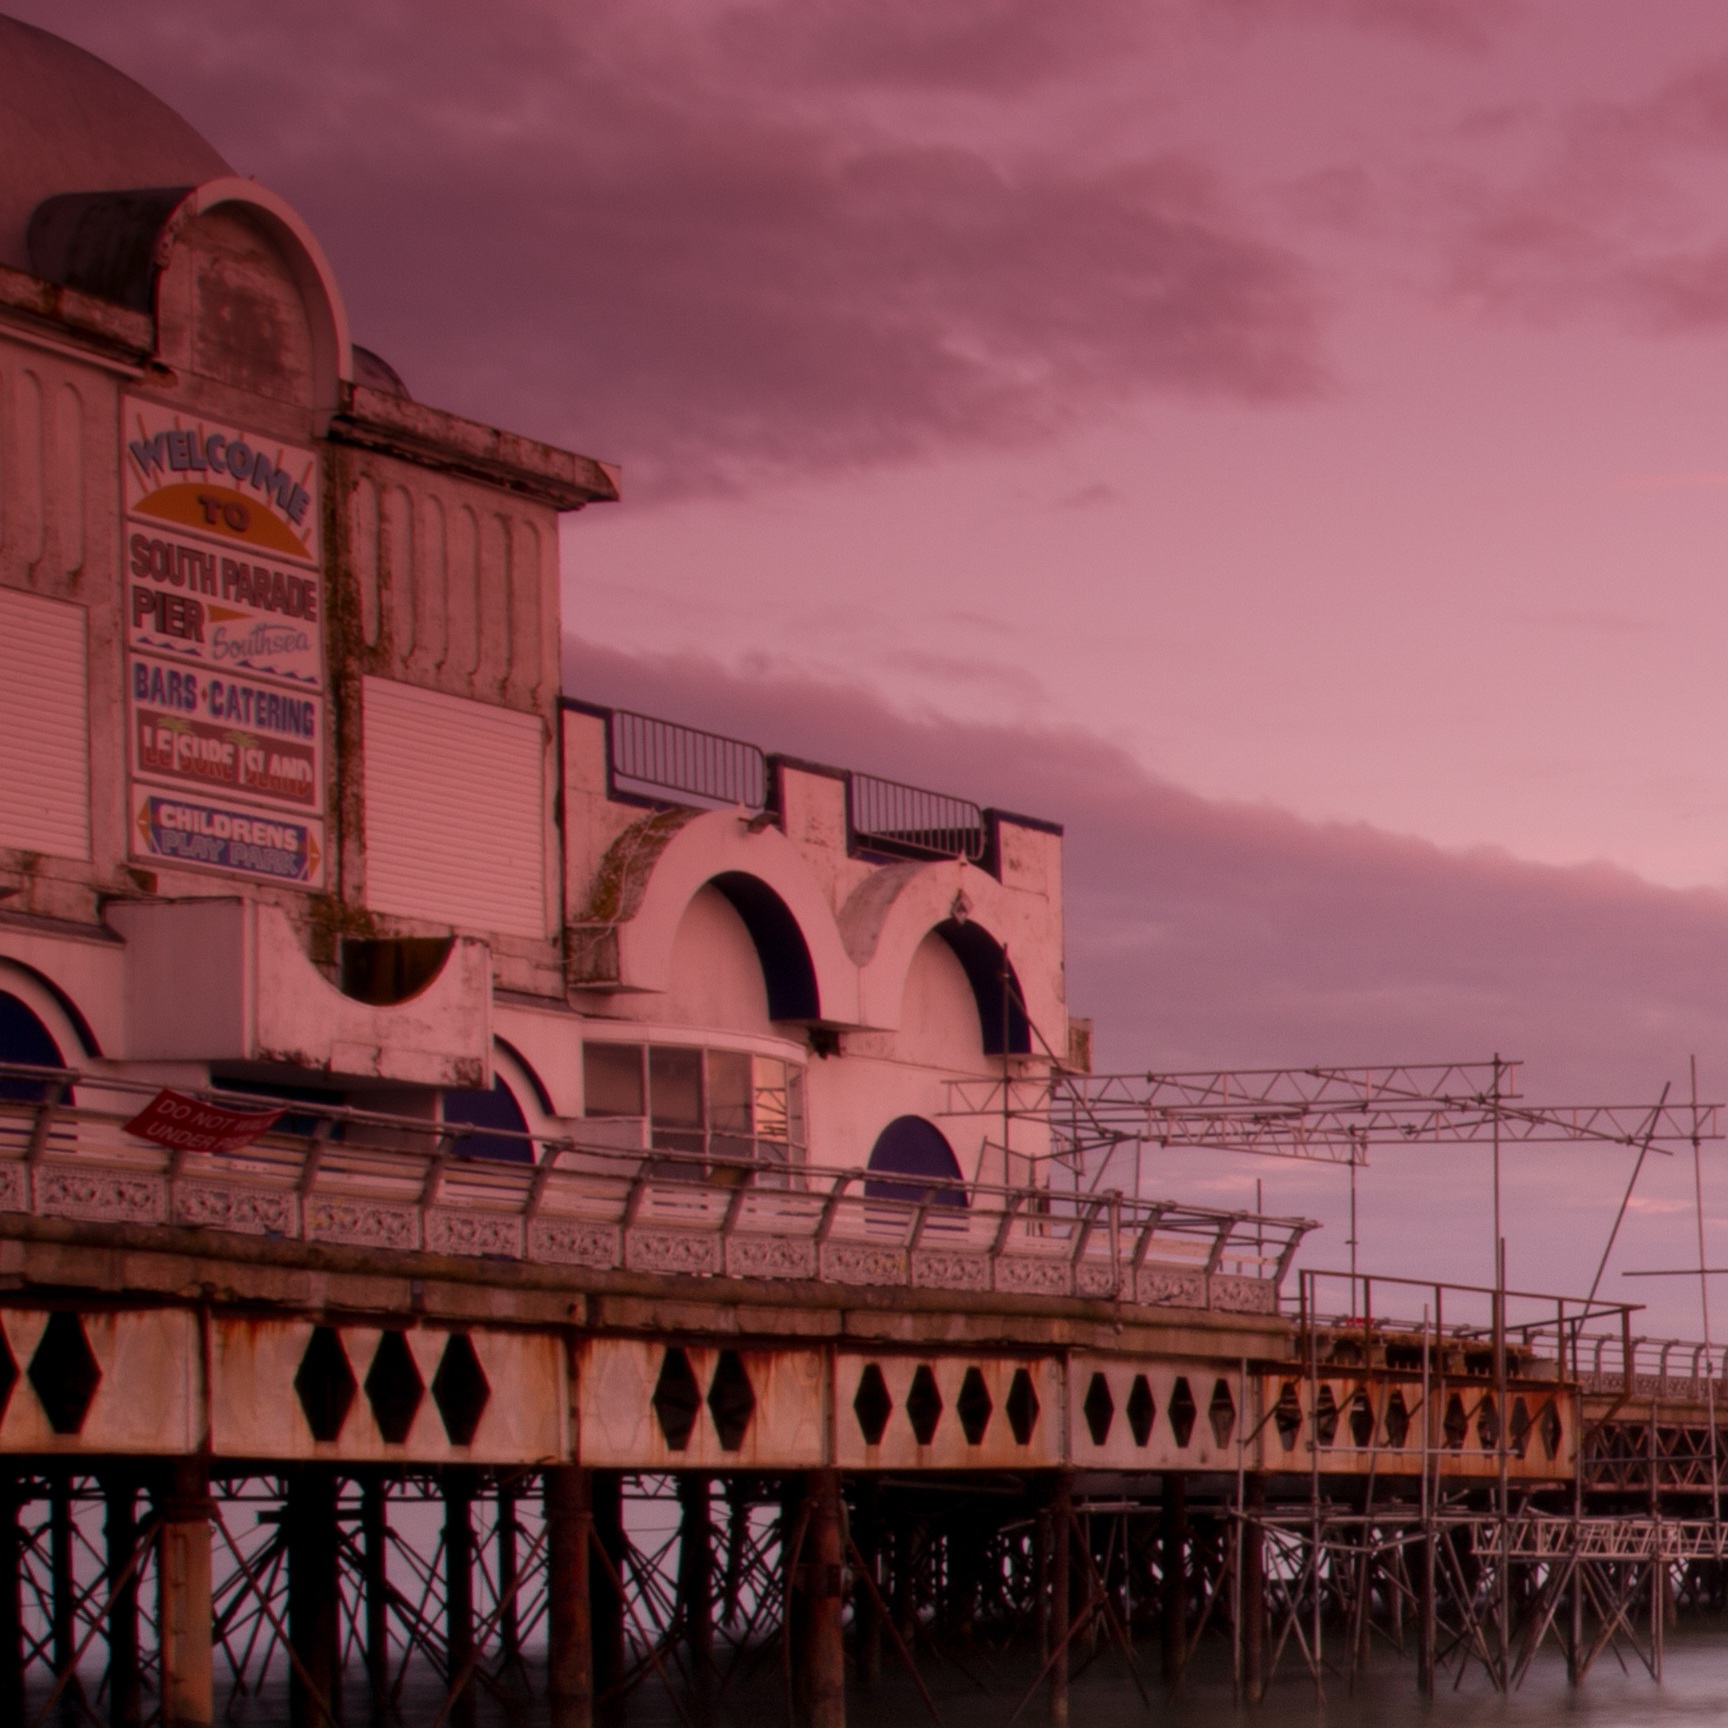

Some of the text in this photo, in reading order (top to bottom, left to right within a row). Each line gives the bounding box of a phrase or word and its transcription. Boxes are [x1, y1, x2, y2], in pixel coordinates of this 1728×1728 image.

[129, 431, 311, 526] WELCOME
[199, 495, 250, 532] TO
[130, 533, 317, 623] SOUTH PARADE
[133, 585, 205, 643] PIER
[212, 622, 309, 660] Southsea
[134, 662, 315, 738] BARS CATERING
[159, 803, 299, 852] CHILDRENS
[160, 829, 299, 875] PLAY PARK
[146, 1121, 217, 1149] UNDER
[156, 1099, 192, 1120] DO
[190, 1111, 236, 1131] NOT
